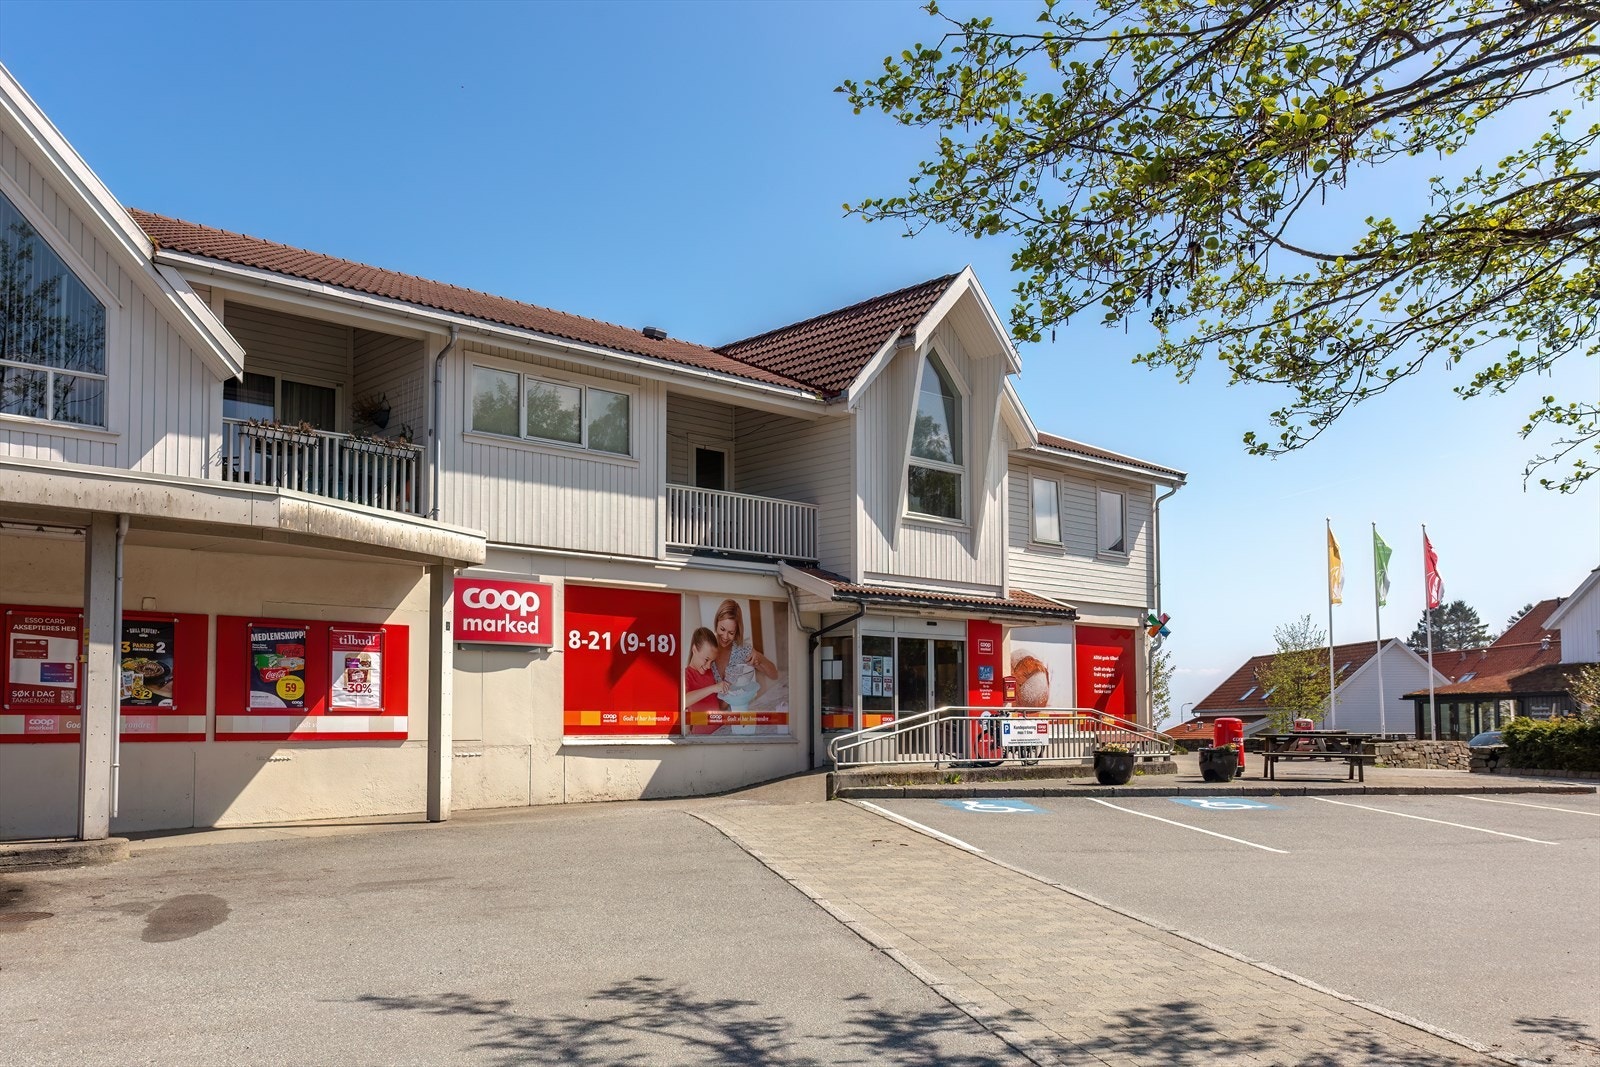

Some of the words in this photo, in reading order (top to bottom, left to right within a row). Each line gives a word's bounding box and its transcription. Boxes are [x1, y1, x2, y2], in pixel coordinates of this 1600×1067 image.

[463, 587, 540, 616] coop
[13, 624, 60, 632] AKSEPTERES
[463, 613, 539, 634] marked
[250, 630, 306, 642] MEDLEMSKUPP!
[339, 634, 376, 646] tilbud!
[121, 641, 131, 653] 3
[156, 641, 166, 654] 2
[568, 630, 611, 650] 8-21
[620, 631, 676, 656] (9-18)
[285, 682, 297, 693] 59
[342, 683, 373, 694] -30%
[12, 690, 30, 698] SØK
[37, 690, 55, 698] DAG
[144, 690, 150, 698] 2
[29, 718, 54, 726] coop
[1004, 724, 1009, 733] P
